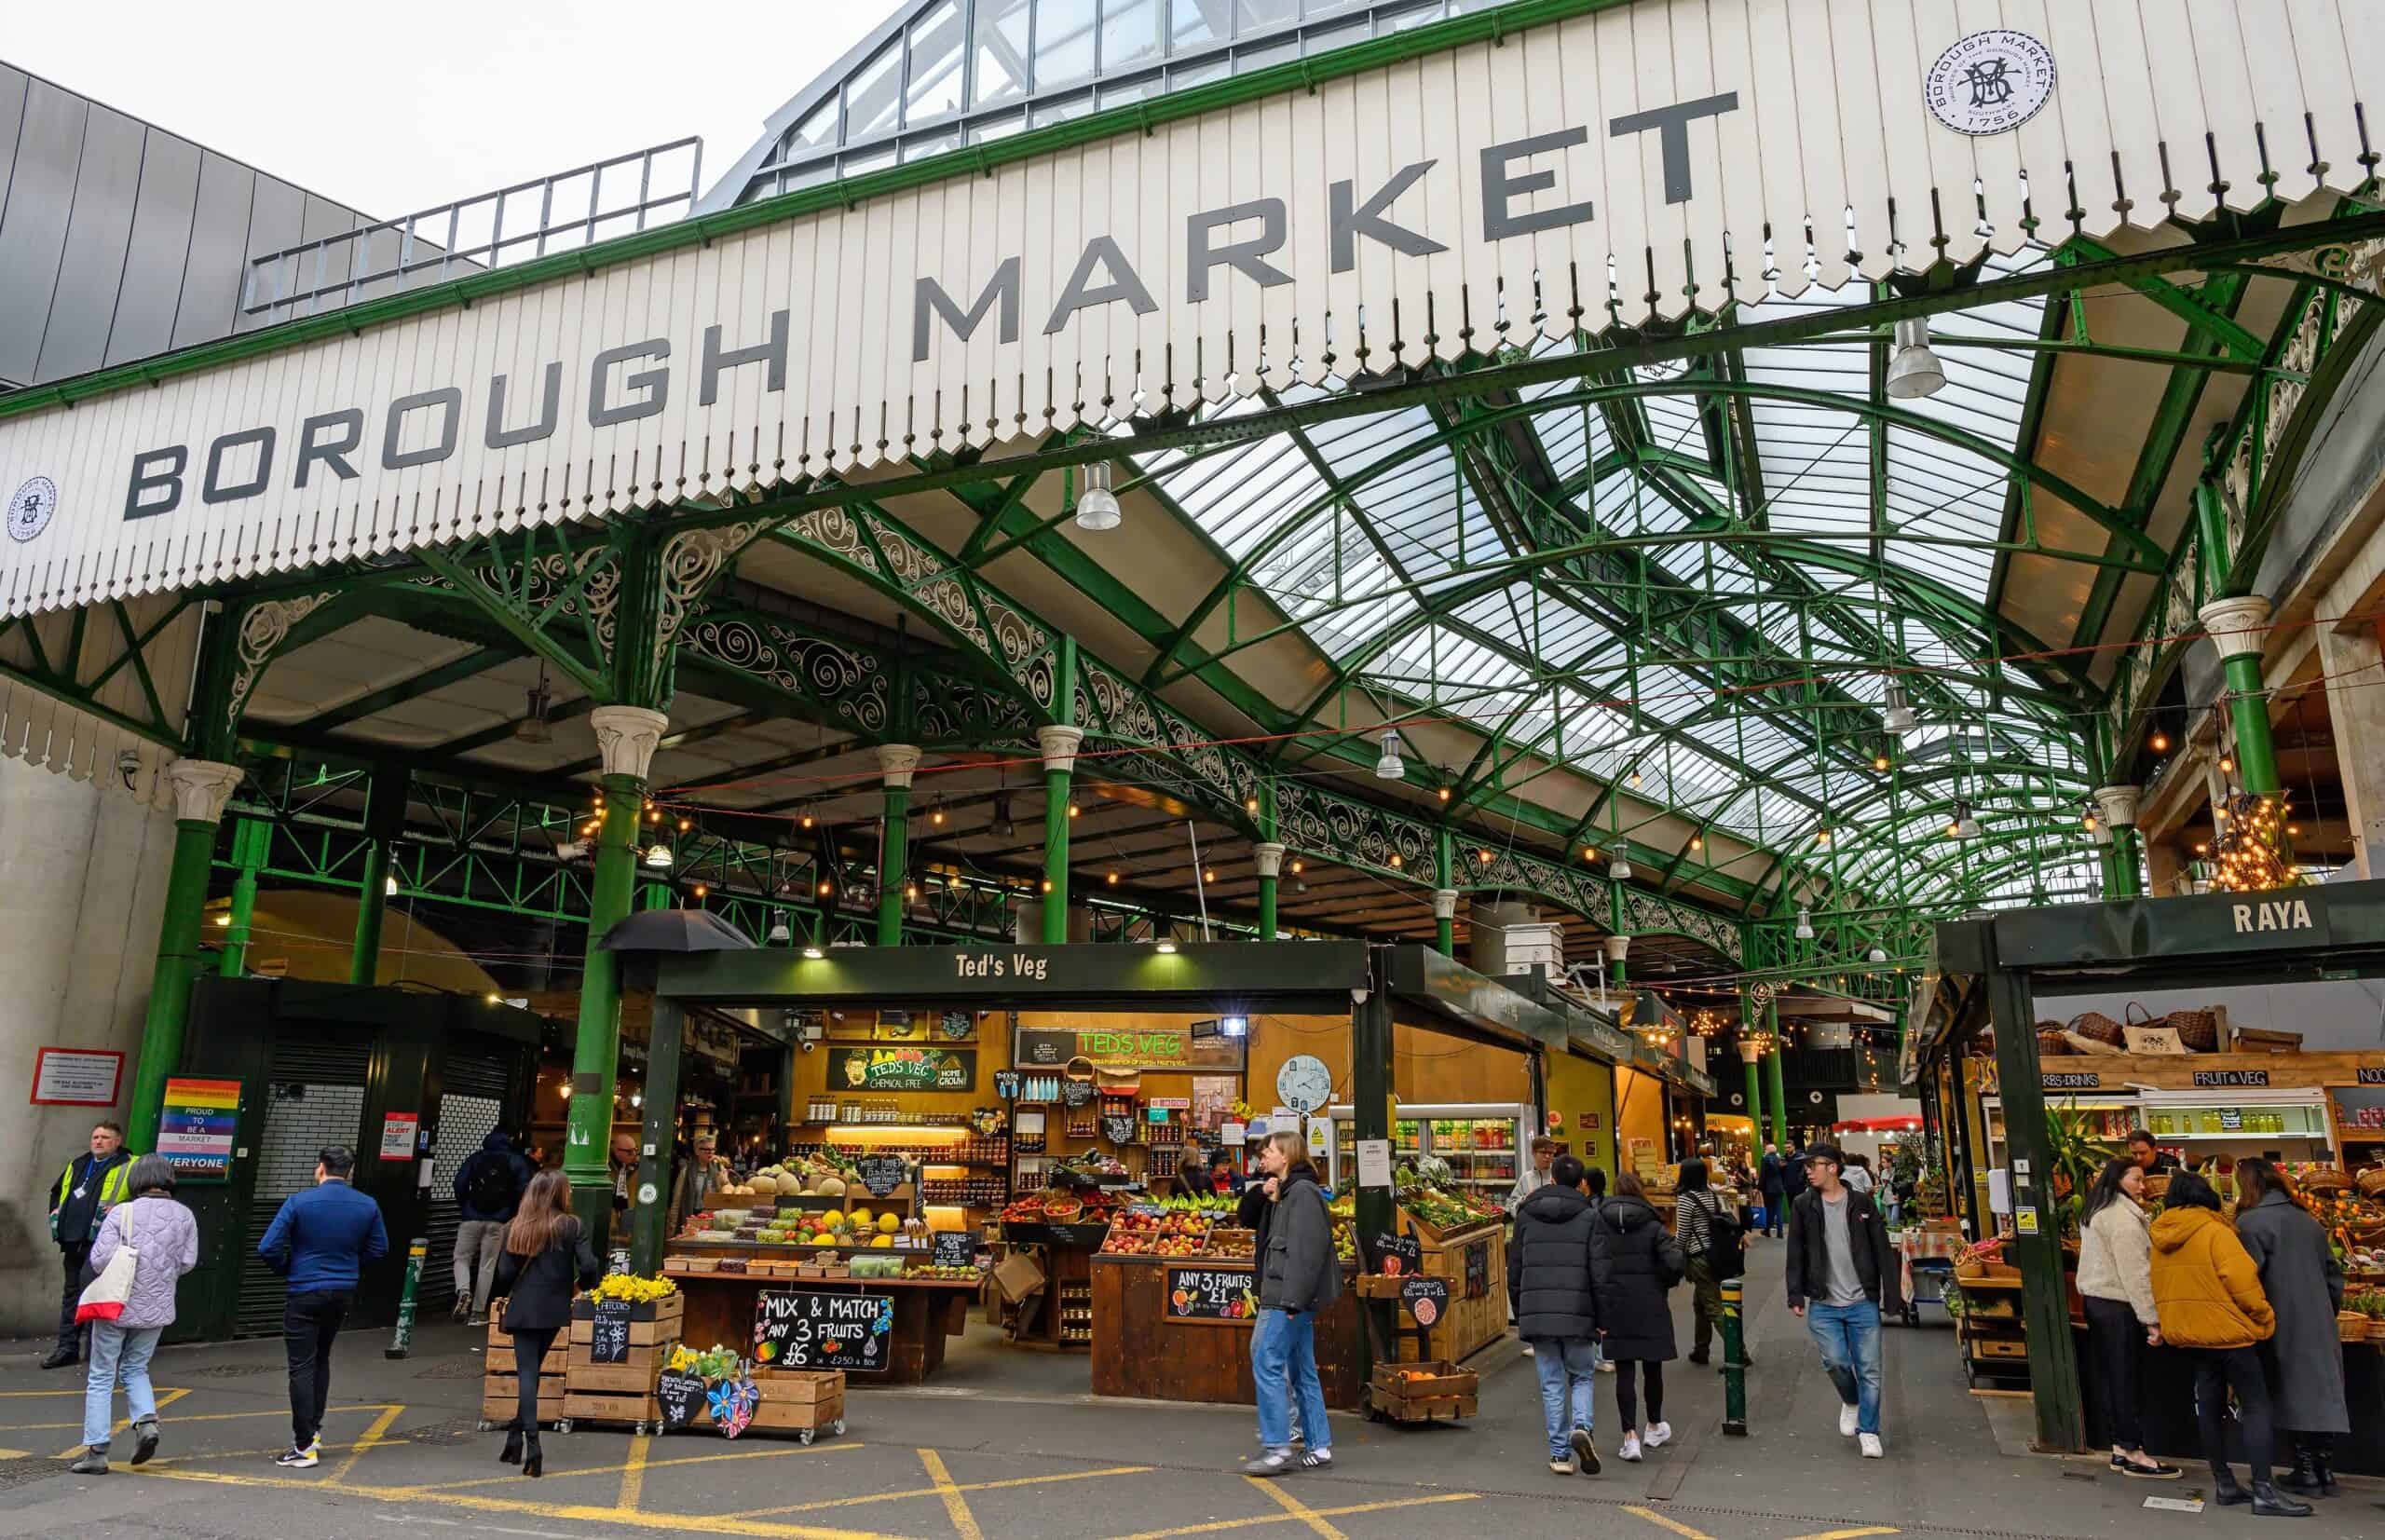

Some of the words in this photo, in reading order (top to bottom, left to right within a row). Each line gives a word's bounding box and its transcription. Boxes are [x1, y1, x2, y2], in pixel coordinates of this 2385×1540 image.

[1933, 36, 1991, 108] BOROUGH
[2001, 35, 2047, 89] MARKET
[1968, 110, 2020, 127] 1756
[123, 308, 790, 521] BOROUGH
[912, 91, 1739, 362] MARKET
[2232, 899, 2313, 933] RAYA
[955, 953, 1005, 977] Ted's
[1013, 953, 1048, 981] Veg
[1078, 1032, 1135, 1055] TEDS
[1139, 1033, 1181, 1055] VEG
[908, 1061, 930, 1077] VEG
[2194, 1071, 2229, 1085] FRUIT
[2237, 1070, 2266, 1085] VEG
[869, 1078, 904, 1089] CHEMICAL
[905, 1079, 922, 1089] FREE
[2064, 1073, 2099, 1086] DRINKS
[185, 1107, 214, 1117] PROUD
[186, 1125, 198, 1134] BE
[193, 1117, 205, 1125] TO
[178, 1135, 211, 1143] MARKET
[1178, 1271, 1201, 1288] ANY
[1200, 1272, 1214, 1292] 3
[1215, 1274, 1253, 1289] FRUITS
[1208, 1287, 1229, 1303] £1
[765, 1296, 798, 1318] MIX
[810, 1296, 823, 1317] &
[829, 1297, 879, 1319] MATCH
[767, 1323, 789, 1339] ANY
[795, 1318, 812, 1342] 3
[817, 1322, 865, 1340] FRUITS
[782, 1342, 810, 1366] £6
